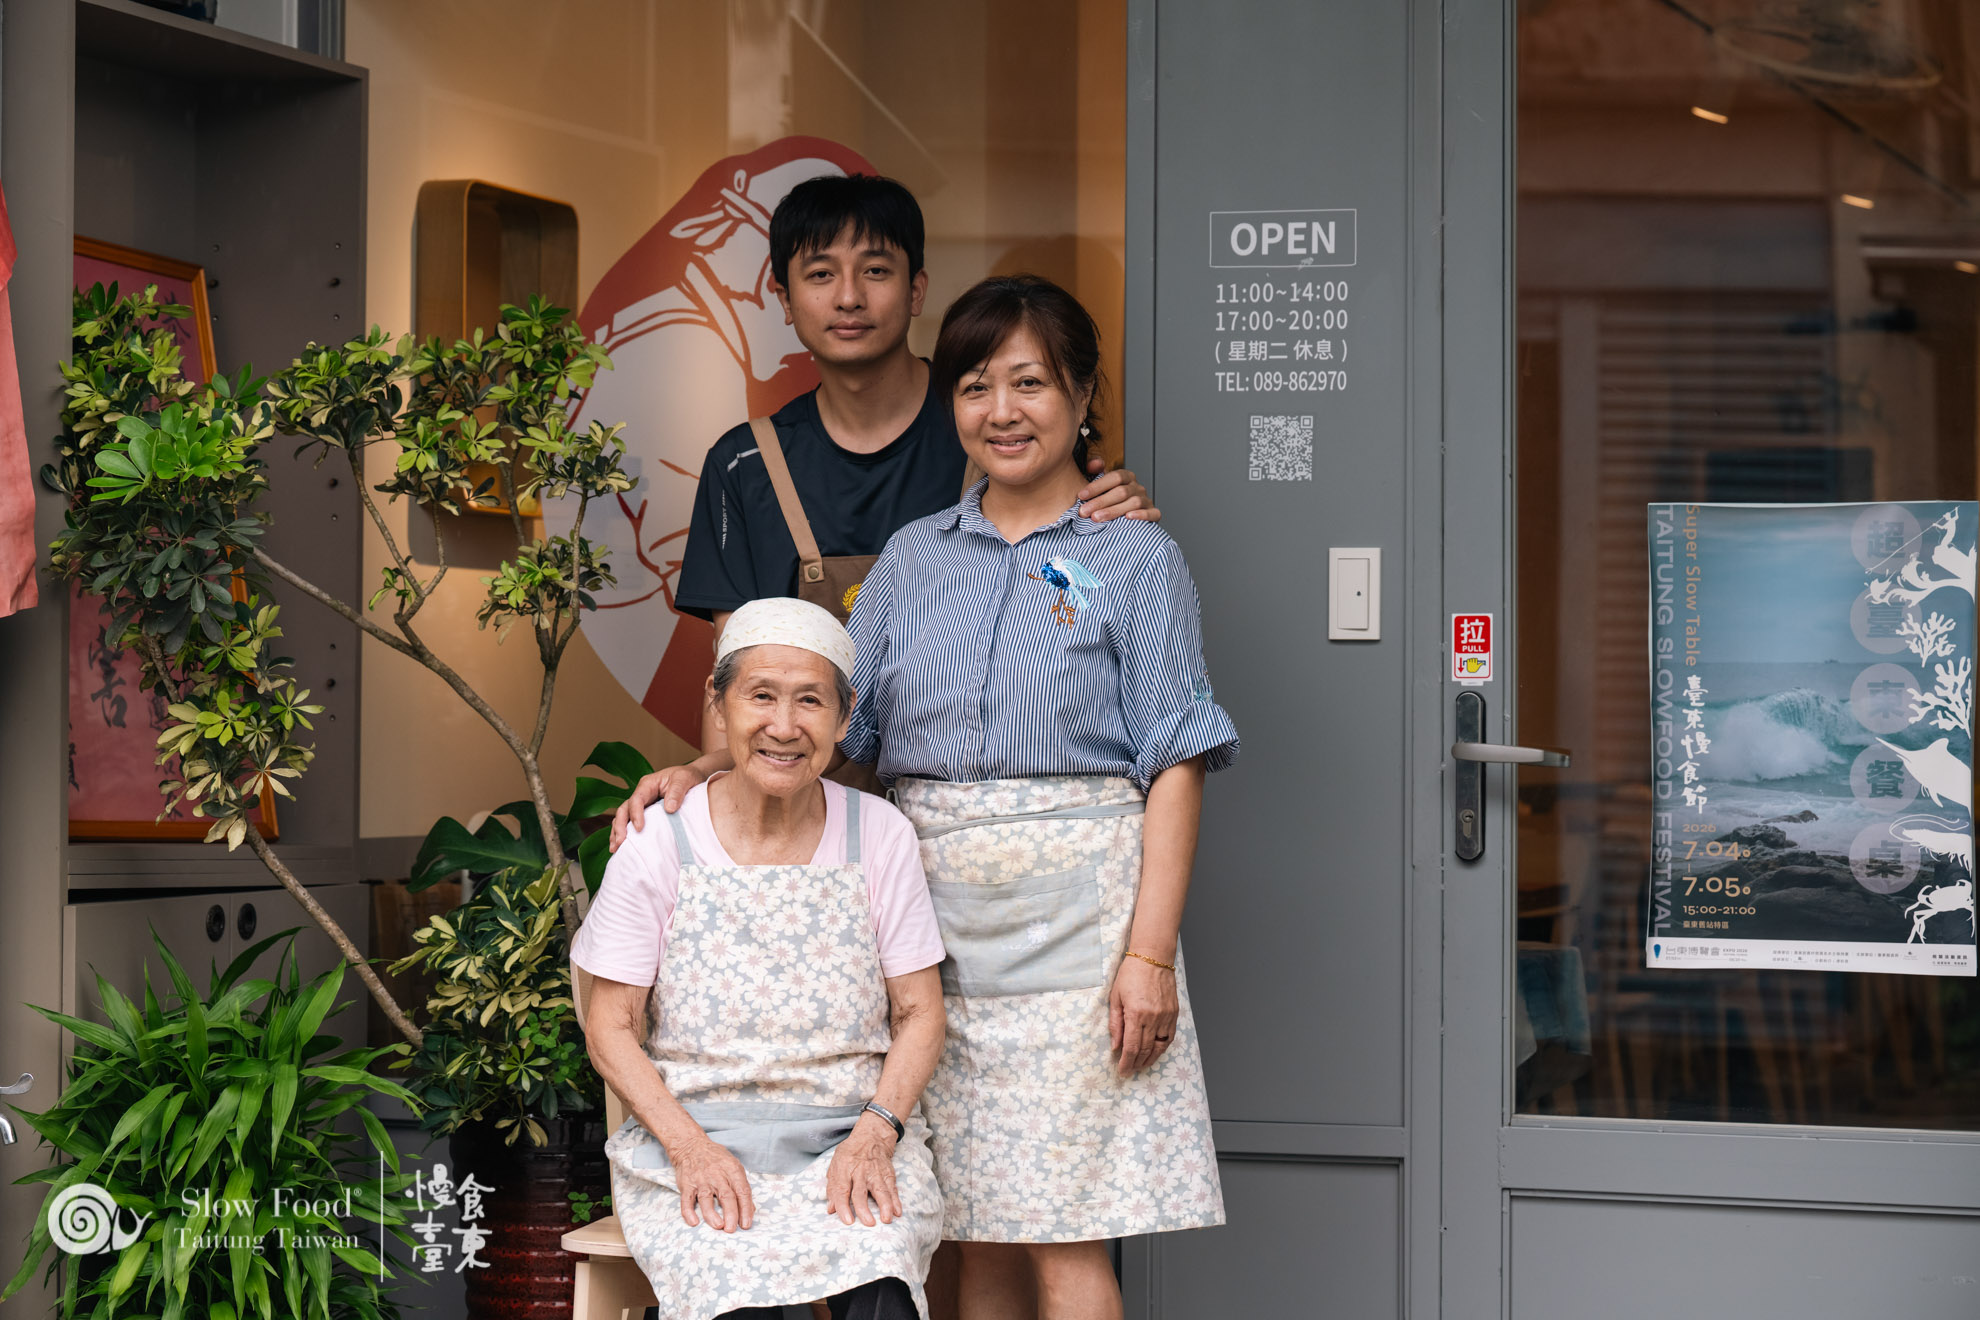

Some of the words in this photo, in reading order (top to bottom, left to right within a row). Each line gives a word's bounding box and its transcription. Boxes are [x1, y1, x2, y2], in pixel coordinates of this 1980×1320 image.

[1230, 221, 1336, 256] OPEN
[1215, 281, 1349, 303] 11:00~14:00
[1215, 309, 1349, 331] 17:00~20:00
[1215, 372, 1250, 391] TEL:
[1253, 371, 1347, 391] 089-862970
[1683, 504, 1701, 560] Super
[1656, 504, 1674, 626] TAITUNG
[1685, 565, 1701, 611] Slow
[1460, 618, 1486, 644] 拉
[1685, 616, 1701, 667] Table
[1655, 636, 1674, 800] SLOWFOOD
[1682, 823, 1717, 833] 2026
[1682, 841, 1741, 861] 7.04
[1653, 812, 1673, 937] FESTIVAL
[1682, 876, 1741, 898] 7.05
[1682, 905, 1756, 916] 15:00-21:00
